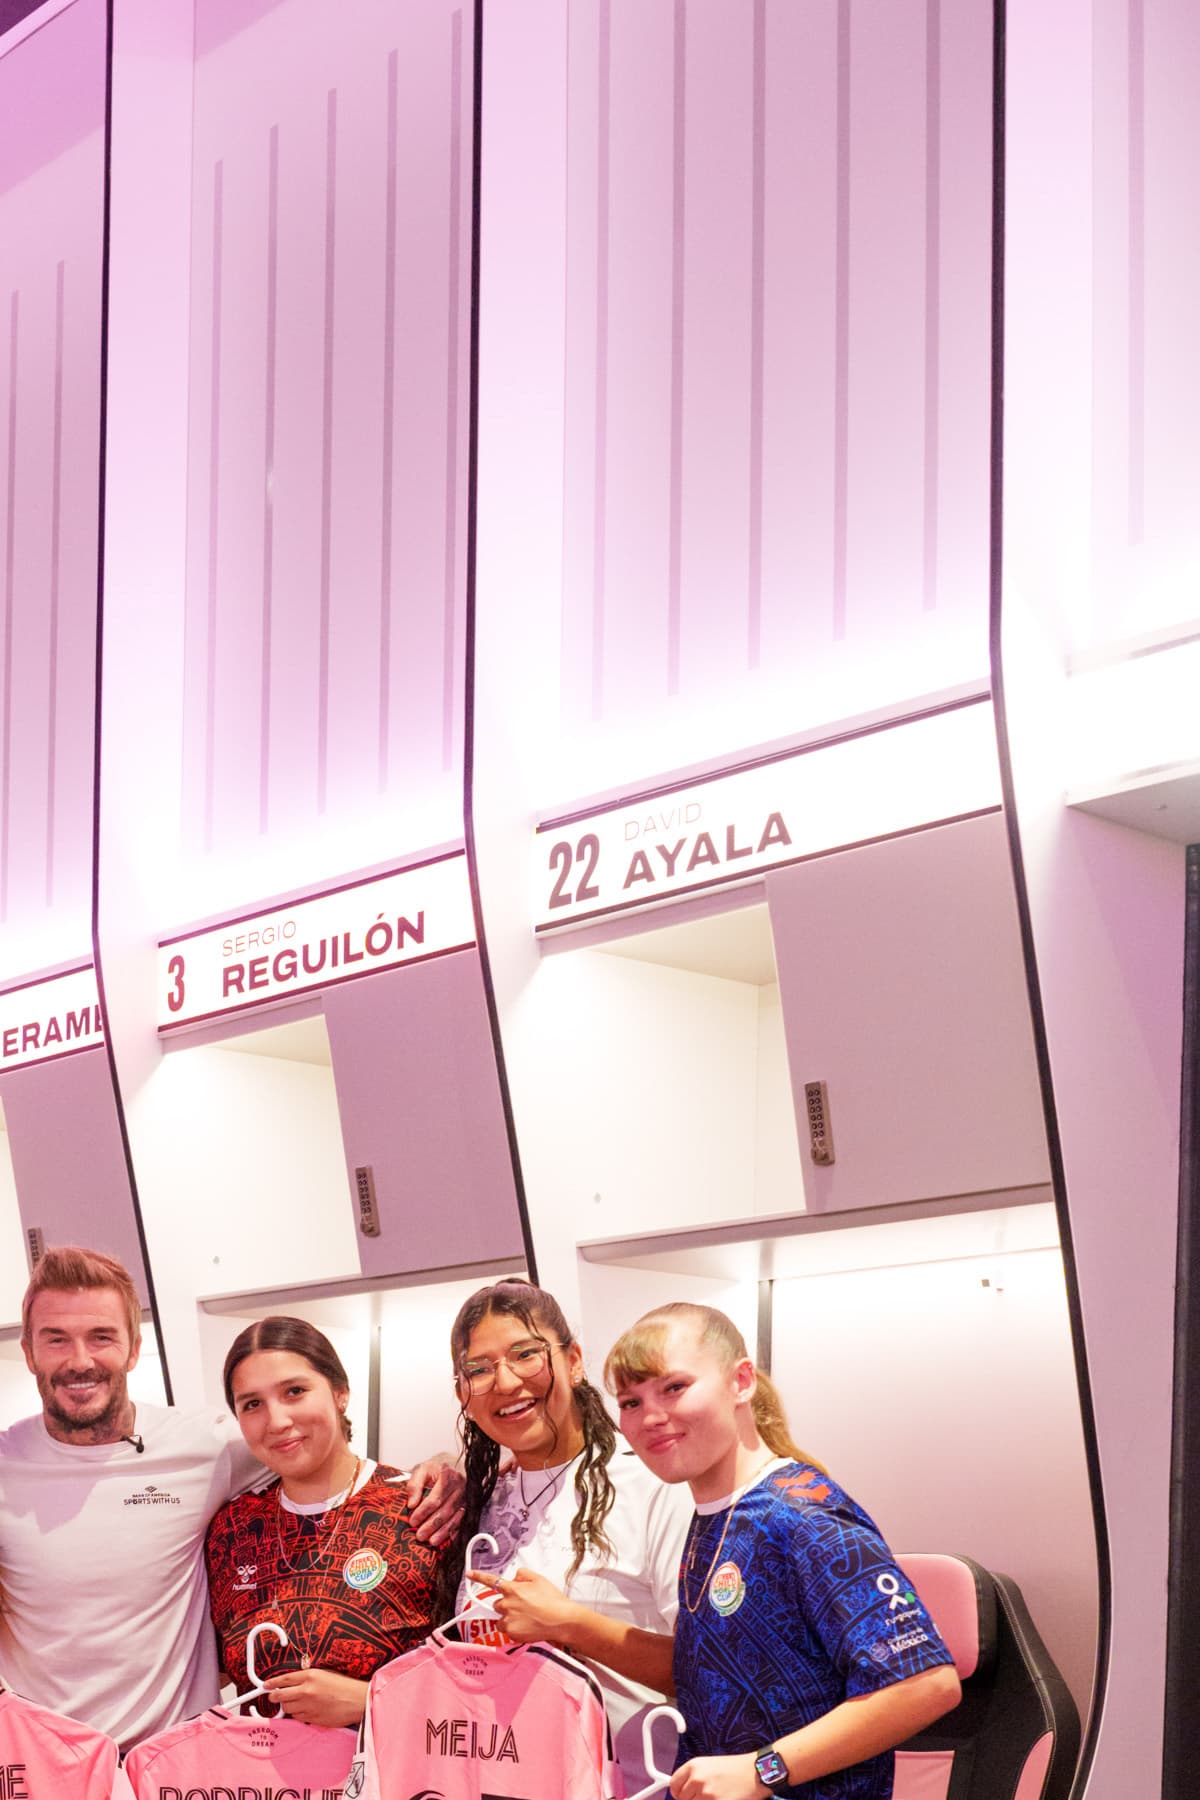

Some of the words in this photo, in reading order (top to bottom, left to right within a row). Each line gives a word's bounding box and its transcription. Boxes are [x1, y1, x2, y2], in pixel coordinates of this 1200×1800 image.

[624, 802, 702, 841] DAVID
[548, 833, 600, 910] 22
[622, 811, 792, 890] AYALA
[222, 920, 297, 957] SERGIO
[167, 955, 185, 1012] 3
[222, 910, 424, 998] REGUILÓN
[151, 1497, 170, 1505] WITH
[426, 1718, 519, 1763] MEIJA
